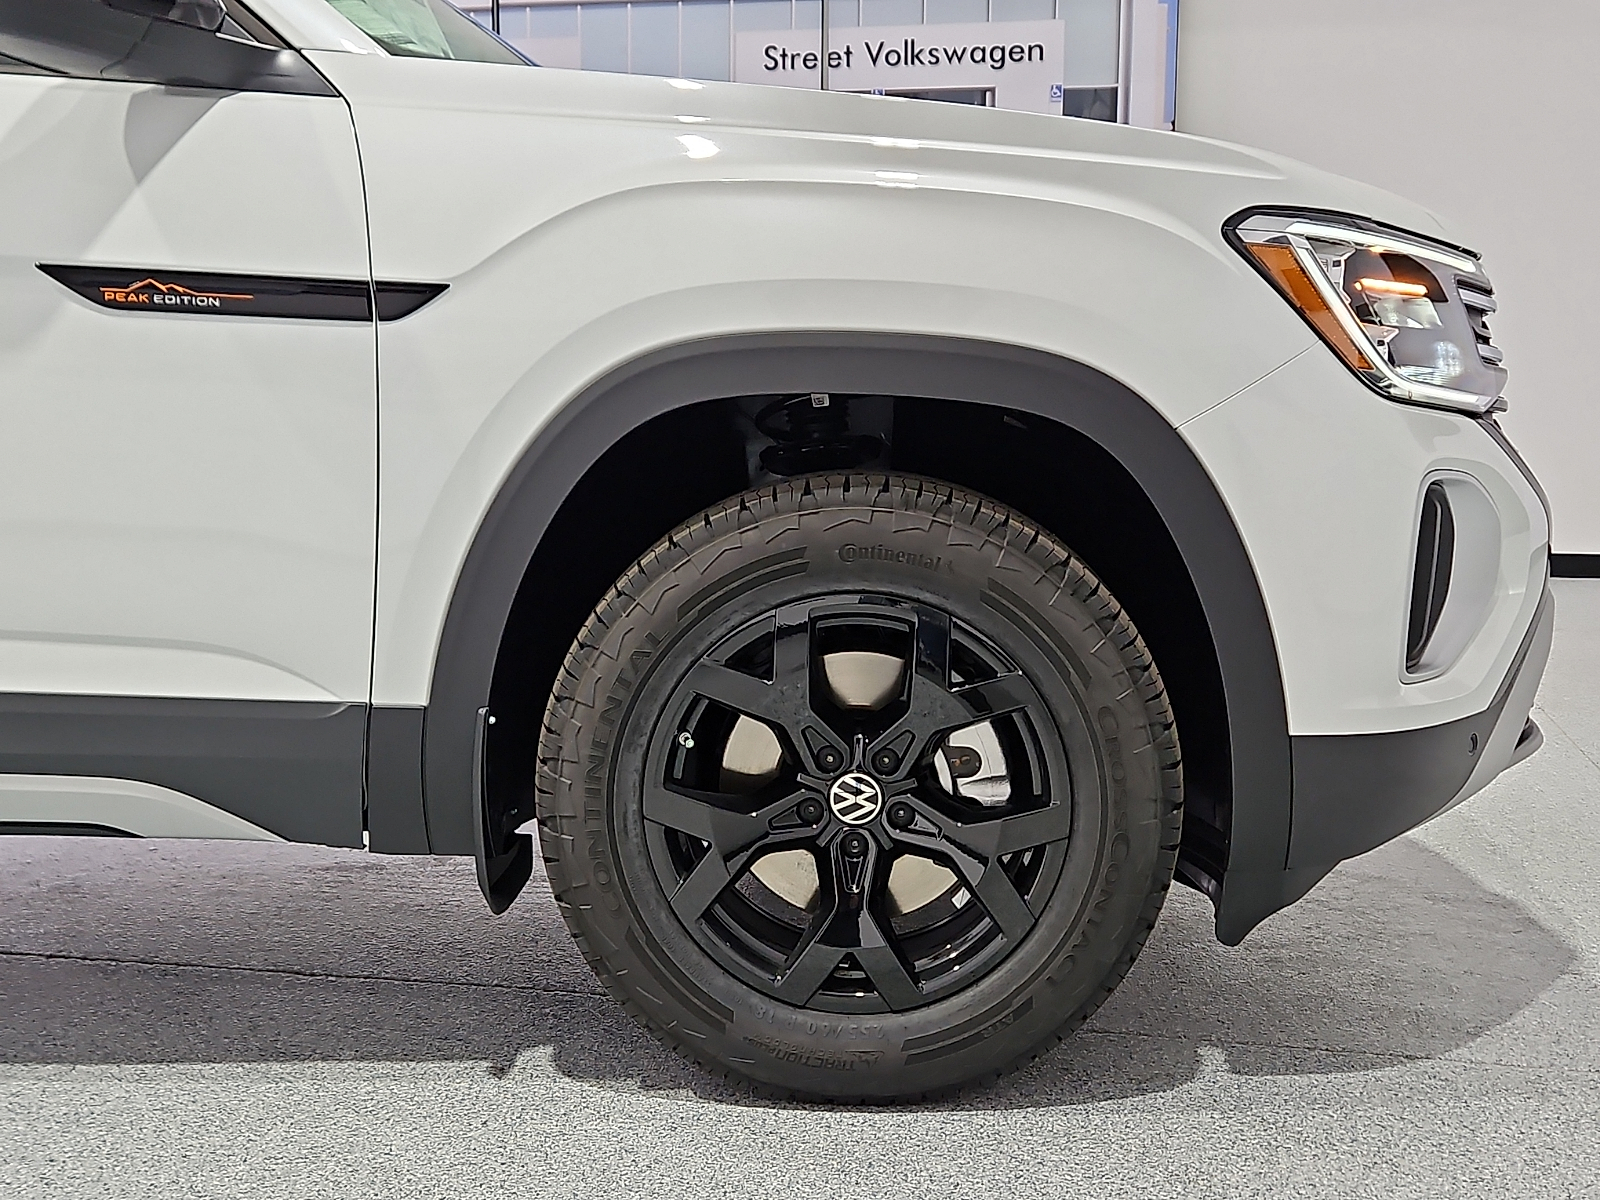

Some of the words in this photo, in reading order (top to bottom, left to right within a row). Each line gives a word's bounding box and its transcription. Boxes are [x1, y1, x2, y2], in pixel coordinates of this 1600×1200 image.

[762, 44, 853, 72] Street
[864, 38, 1045, 70] Volkswagen
[104, 291, 149, 304] PEAK
[153, 293, 220, 308] EDITION
[838, 542, 942, 573] Continental
[584, 629, 671, 920] CONTINENTAL
